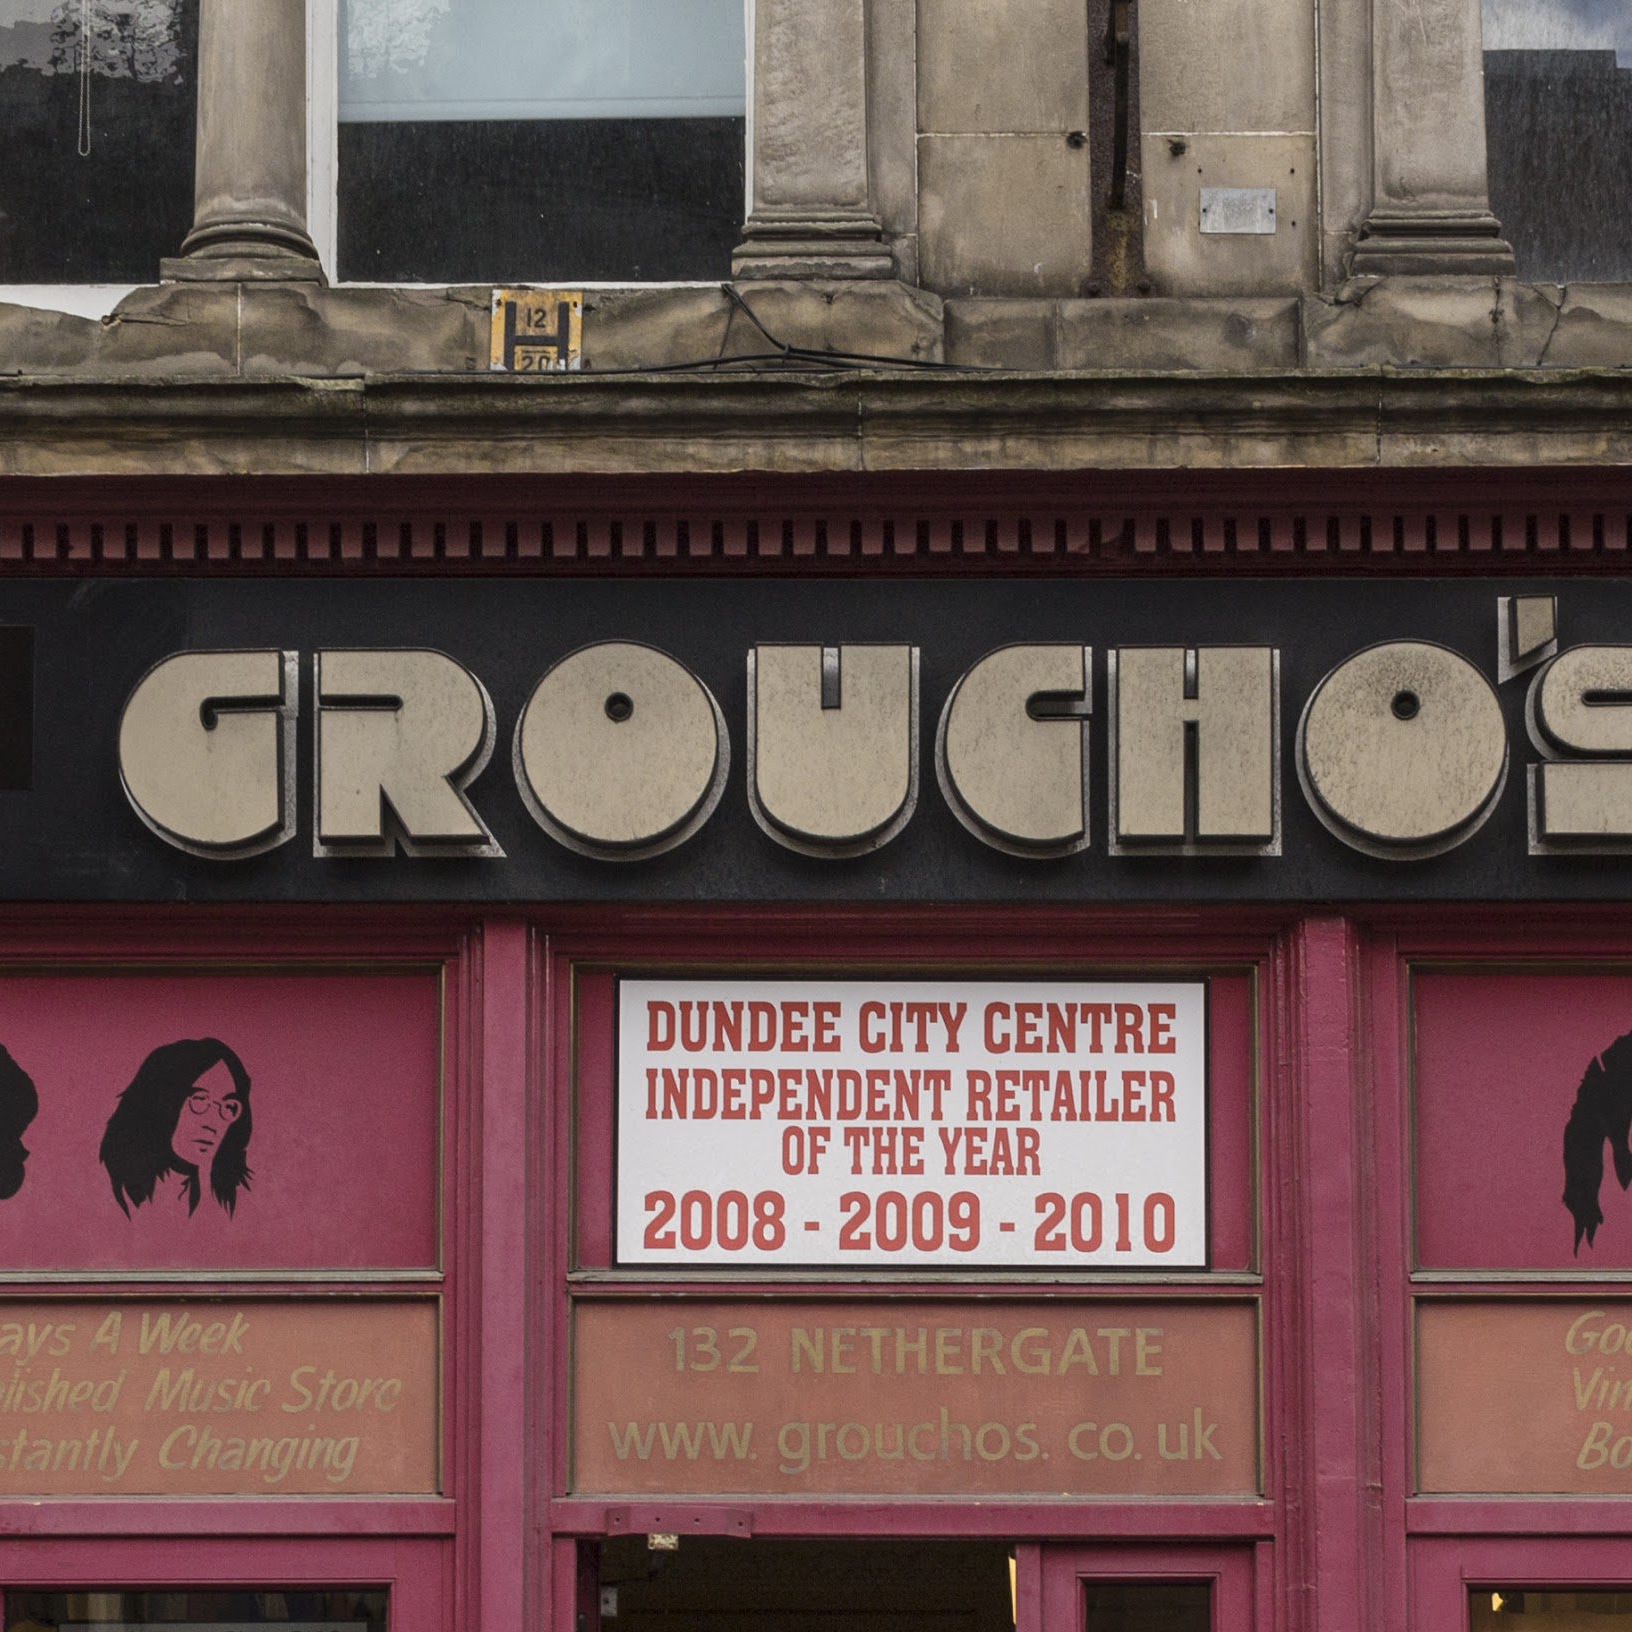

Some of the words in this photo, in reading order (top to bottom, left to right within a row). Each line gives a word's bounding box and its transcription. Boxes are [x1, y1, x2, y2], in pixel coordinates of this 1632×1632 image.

[527, 308, 546, 328] 12
[647, 1001, 841, 1052] DUNDEE
[858, 1001, 967, 1053] CITY
[984, 1002, 1176, 1054] CENTRE
[645, 1068, 951, 1121] INDEPENDENT
[966, 1070, 1176, 1122] RETAILER
[782, 1126, 827, 1175] OF
[844, 1127, 925, 1175] THE
[939, 1127, 1041, 1176] YEAR
[644, 1189, 786, 1251] 2008
[839, 1191, 981, 1252] 2009
[1034, 1192, 1176, 1253] 2010
[89, 1311, 122, 1355] A
[138, 1311, 250, 1355] Week
[670, 1327, 759, 1373] 132
[791, 1327, 1164, 1377] NETHERGATE
[144, 1366, 271, 1413] Music
[282, 1365, 403, 1413] Store
[158, 1423, 360, 1484] Changing
